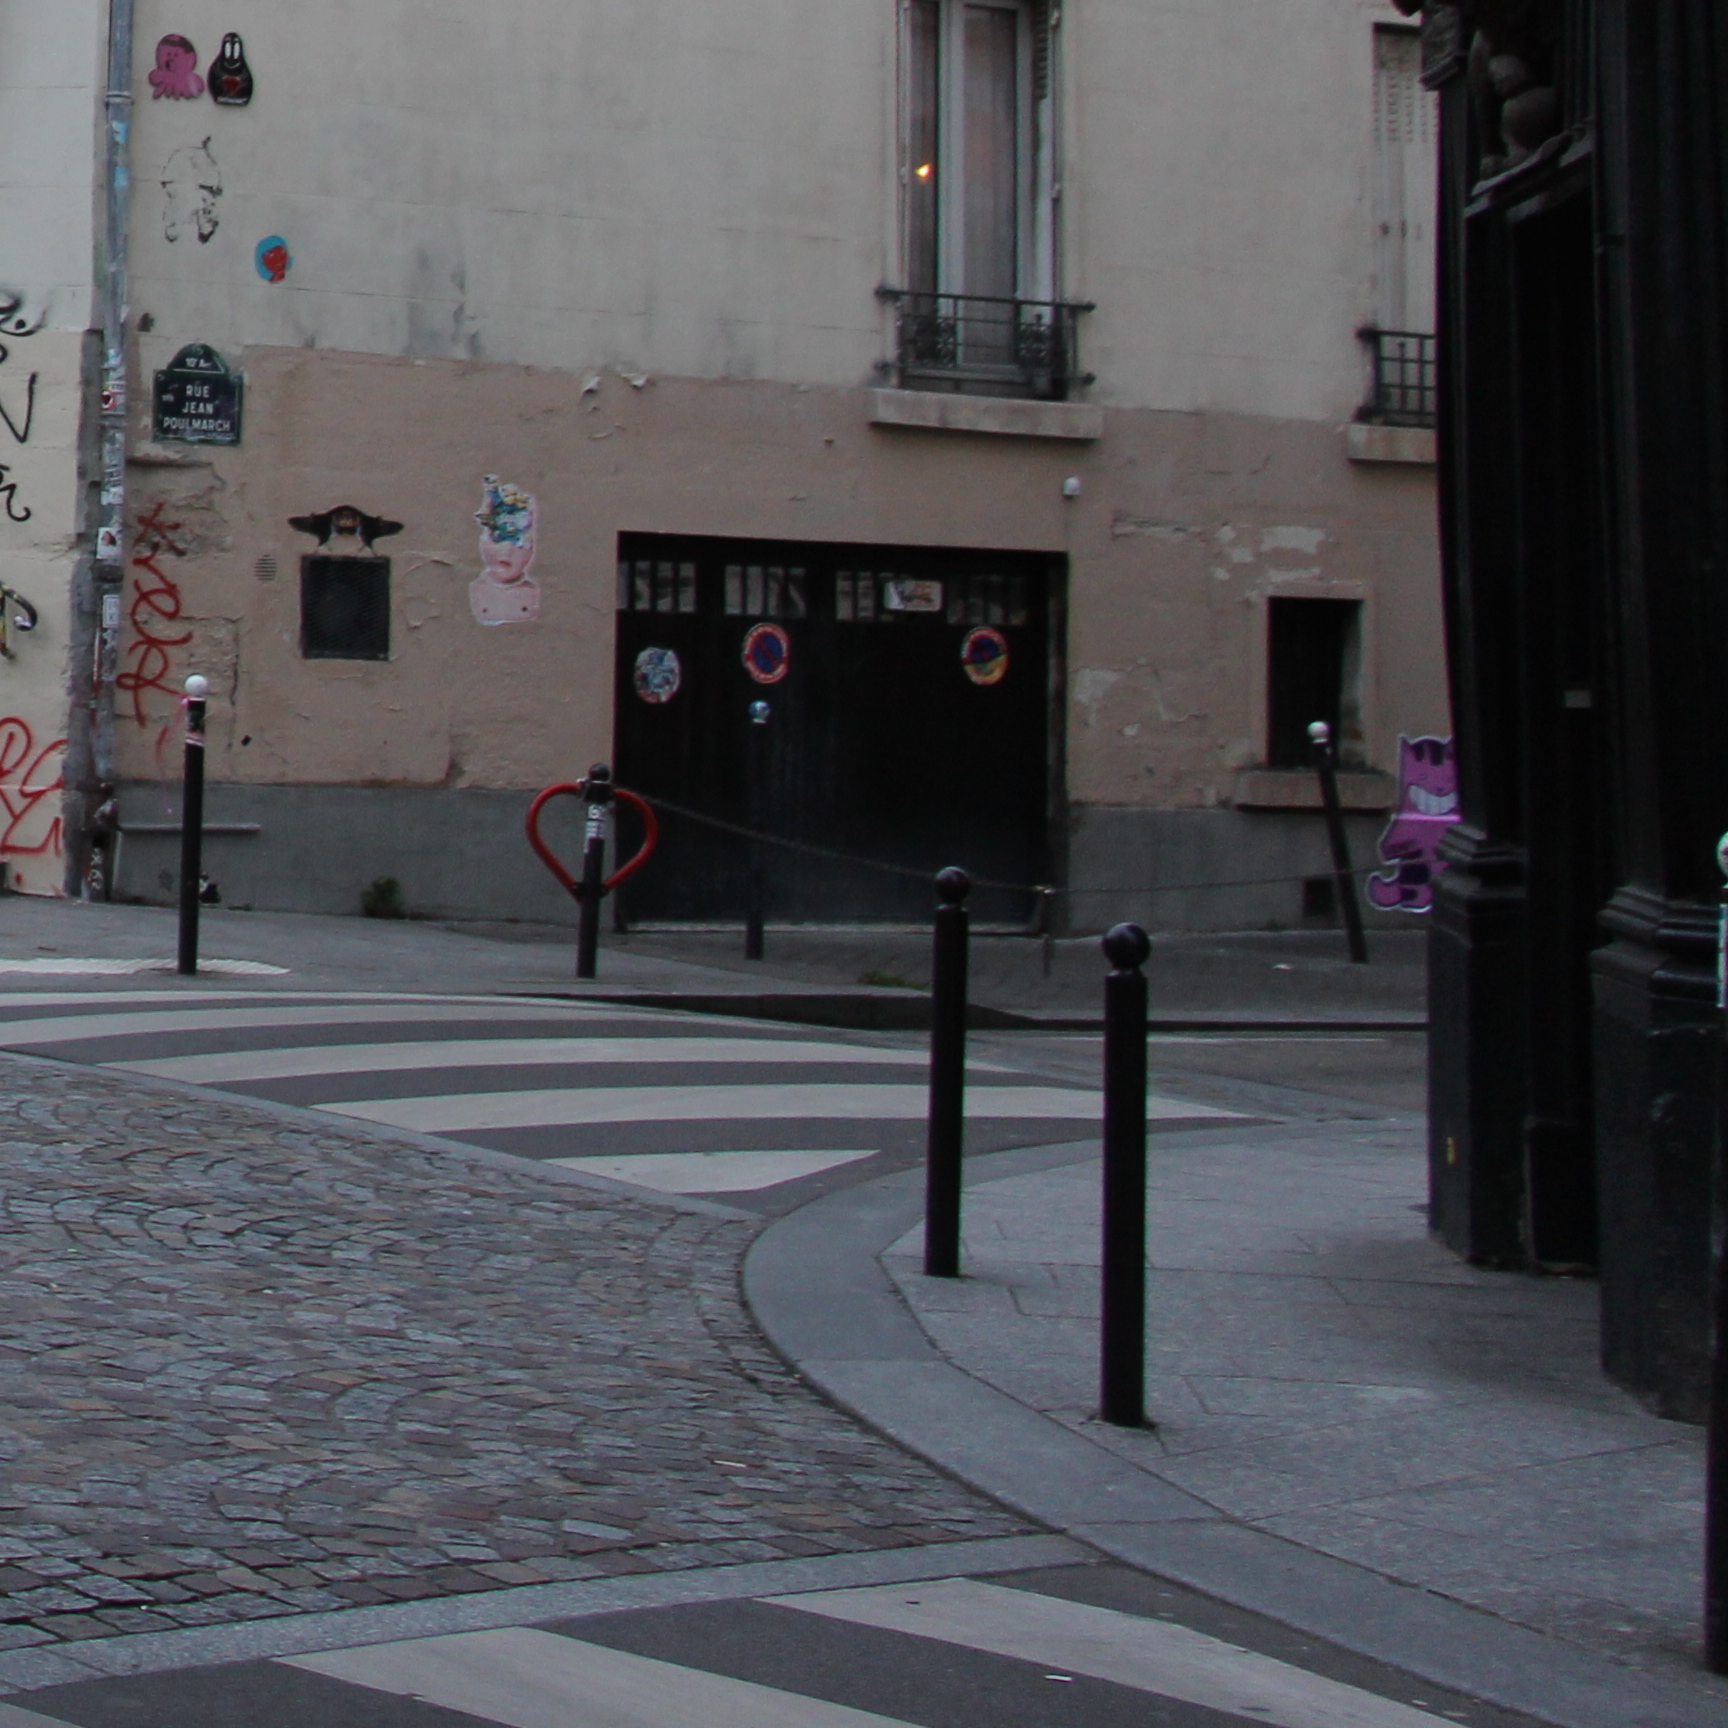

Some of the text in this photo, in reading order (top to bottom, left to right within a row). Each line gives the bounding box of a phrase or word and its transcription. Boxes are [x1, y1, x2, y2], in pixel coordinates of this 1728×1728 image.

[185, 384, 210, 398] RUE
[182, 401, 214, 414] JEAN
[163, 417, 231, 432] POULMARCH
